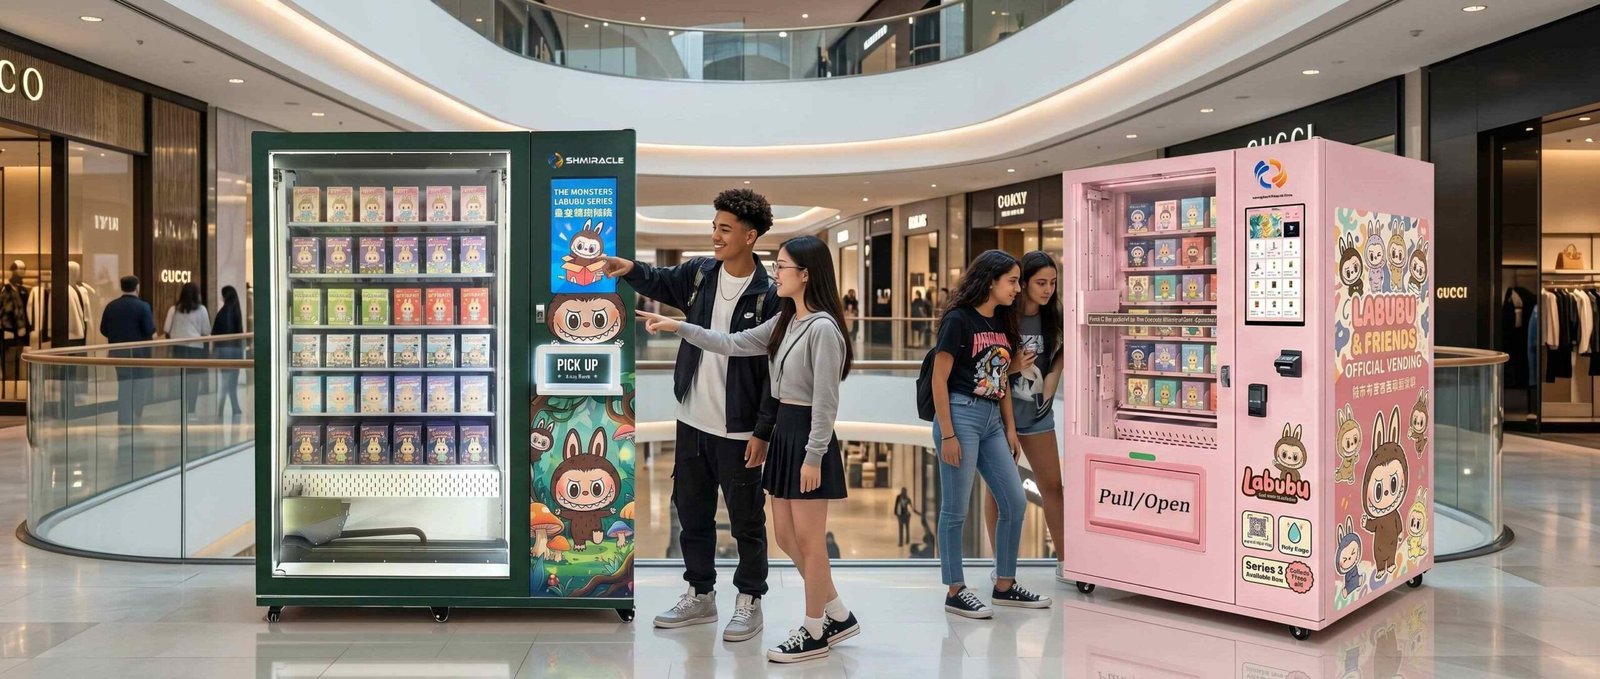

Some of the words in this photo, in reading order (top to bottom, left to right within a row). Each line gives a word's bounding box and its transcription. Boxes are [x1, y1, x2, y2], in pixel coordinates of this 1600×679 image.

[554, 198, 585, 206] LABUBU
[587, 197, 613, 205] SERIES
[161, 269, 192, 284] GUCCI
[1436, 286, 1468, 300] GUCCI
[1352, 296, 1416, 327] LABUBU
[1352, 332, 1362, 356] &
[1364, 328, 1416, 353] FRIENDS
[557, 358, 581, 371] PICK
[584, 358, 598, 371] UP
[1345, 360, 1385, 378] OFFICIAL
[1386, 354, 1422, 373] VENDING
[1242, 466, 1310, 501] Labubu
[1098, 488, 1191, 514] Pull/Open
[1245, 560, 1276, 574] Series
[1277, 565, 1284, 576] 3
